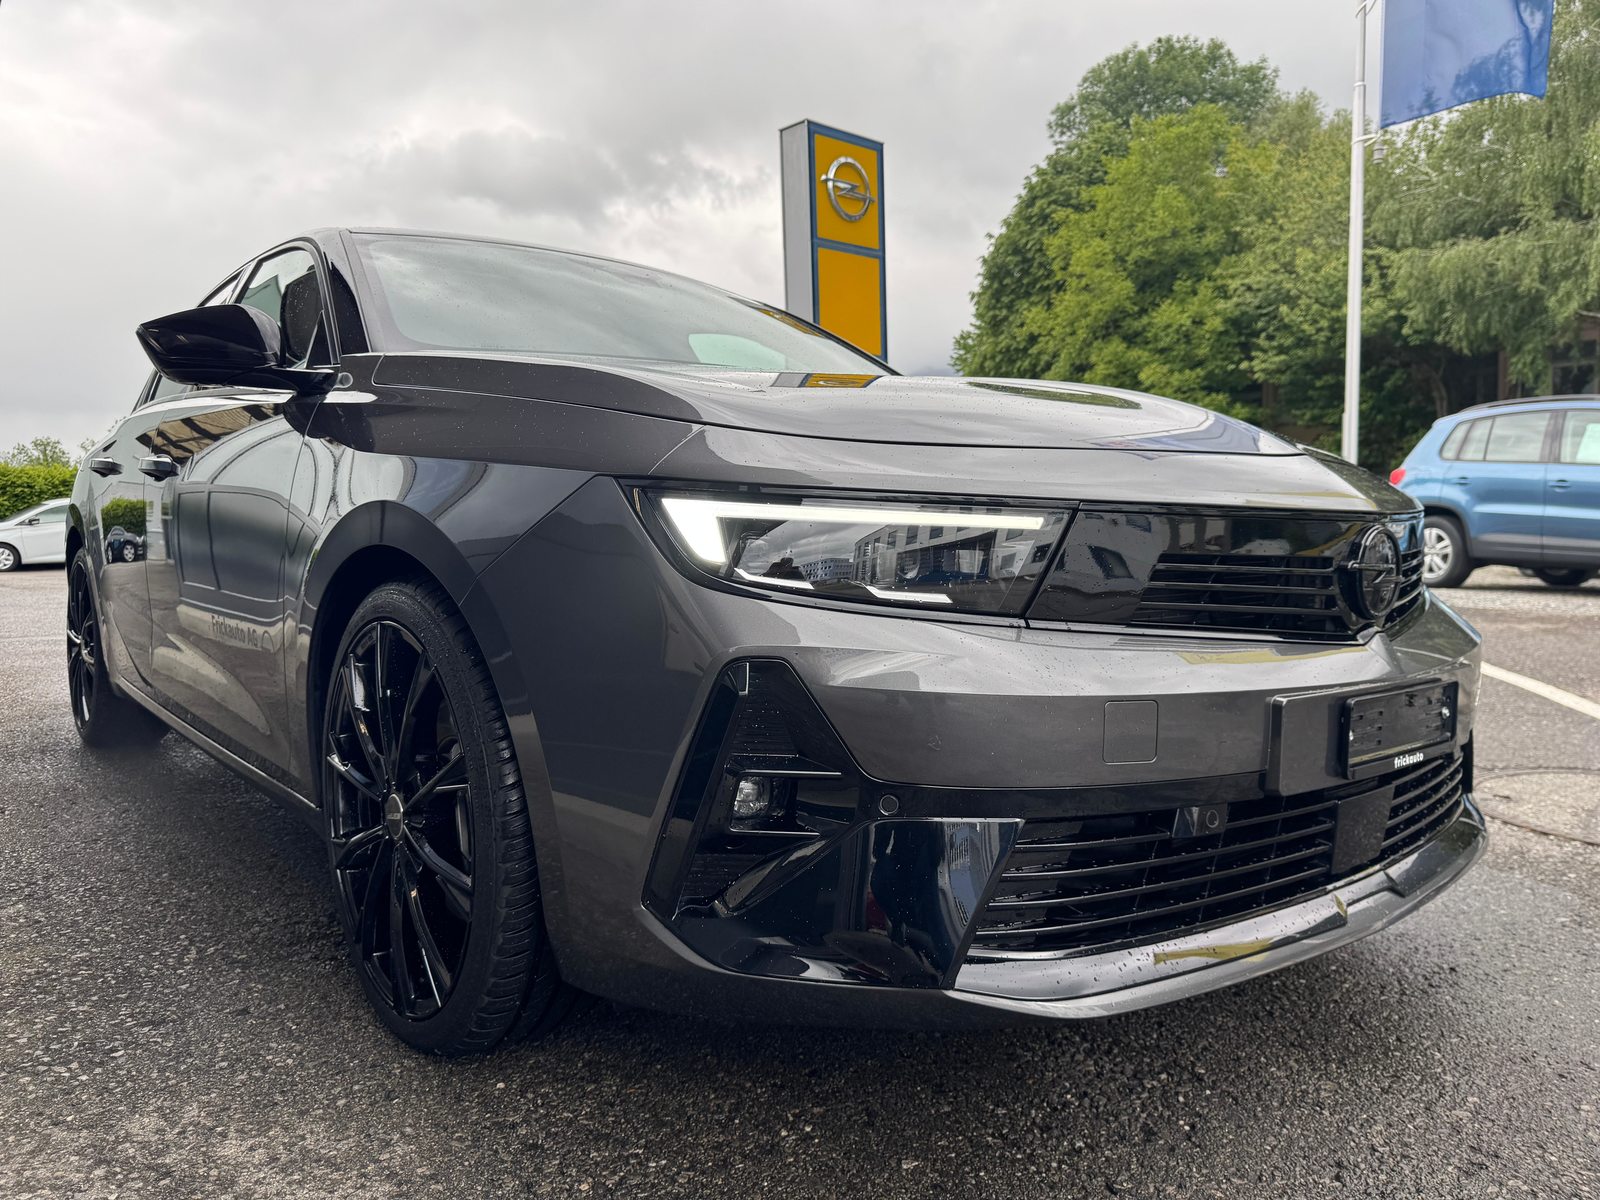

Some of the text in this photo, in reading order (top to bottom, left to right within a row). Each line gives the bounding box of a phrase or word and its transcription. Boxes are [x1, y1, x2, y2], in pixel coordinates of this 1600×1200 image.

[211, 614, 259, 649] Frickauto AG
[1394, 752, 1424, 769] frickauto
